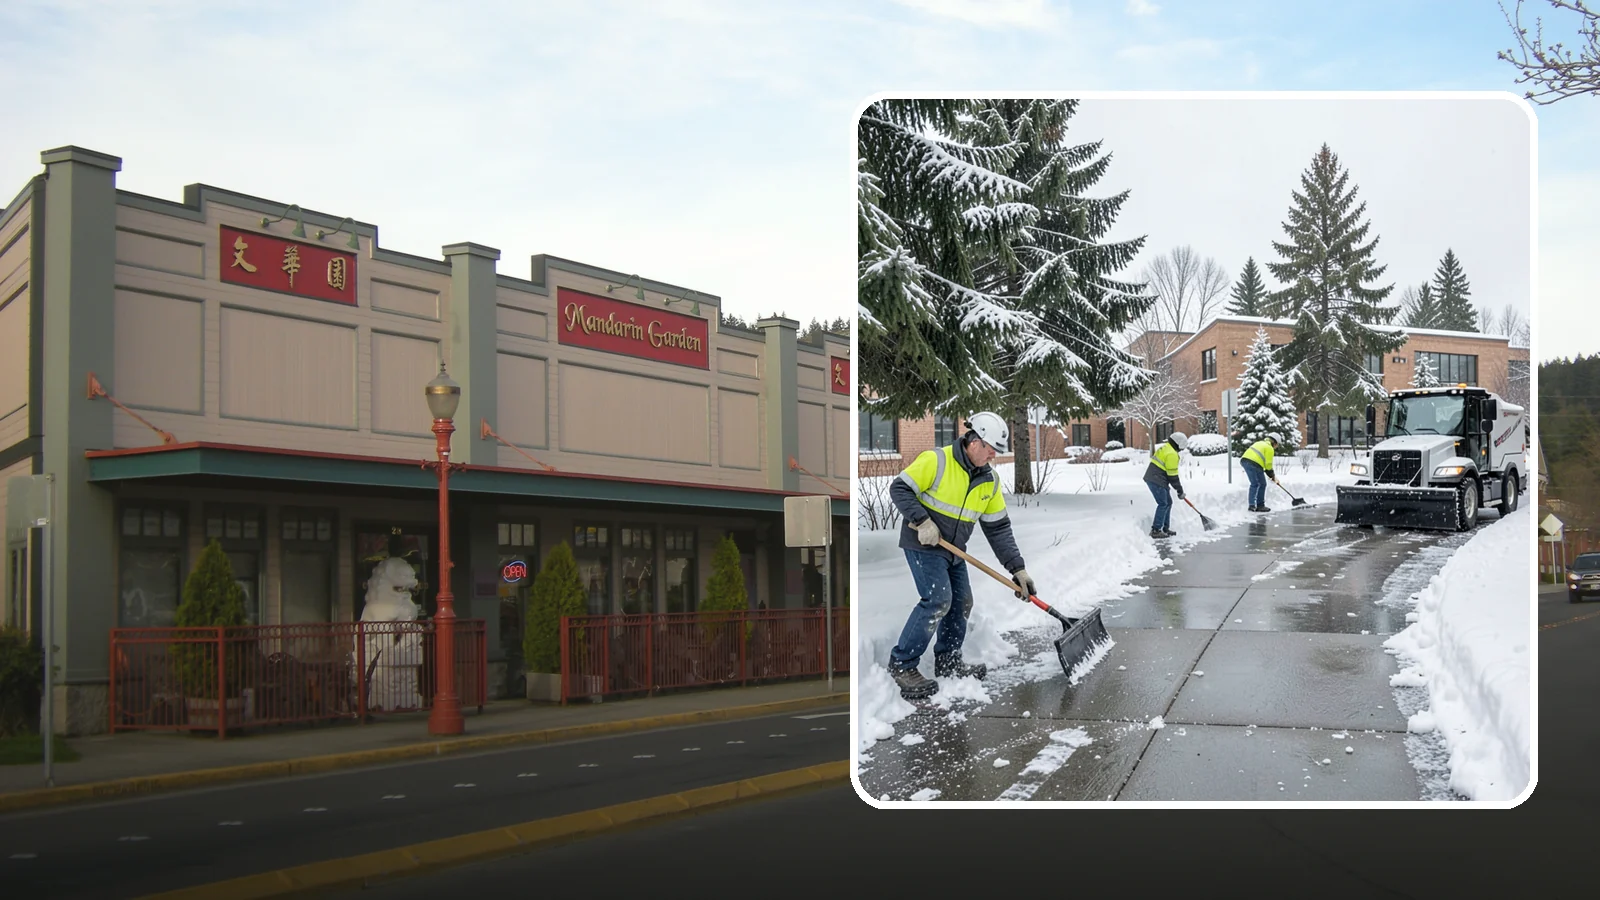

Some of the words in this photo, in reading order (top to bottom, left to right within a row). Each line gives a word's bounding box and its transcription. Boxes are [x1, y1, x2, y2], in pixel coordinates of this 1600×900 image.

[231, 236, 346, 290] 文華園
[564, 302, 644, 341] Mandarin
[648, 320, 701, 352] Garden
[834, 363, 846, 386] 文
[503, 565, 527, 578] OPEN
